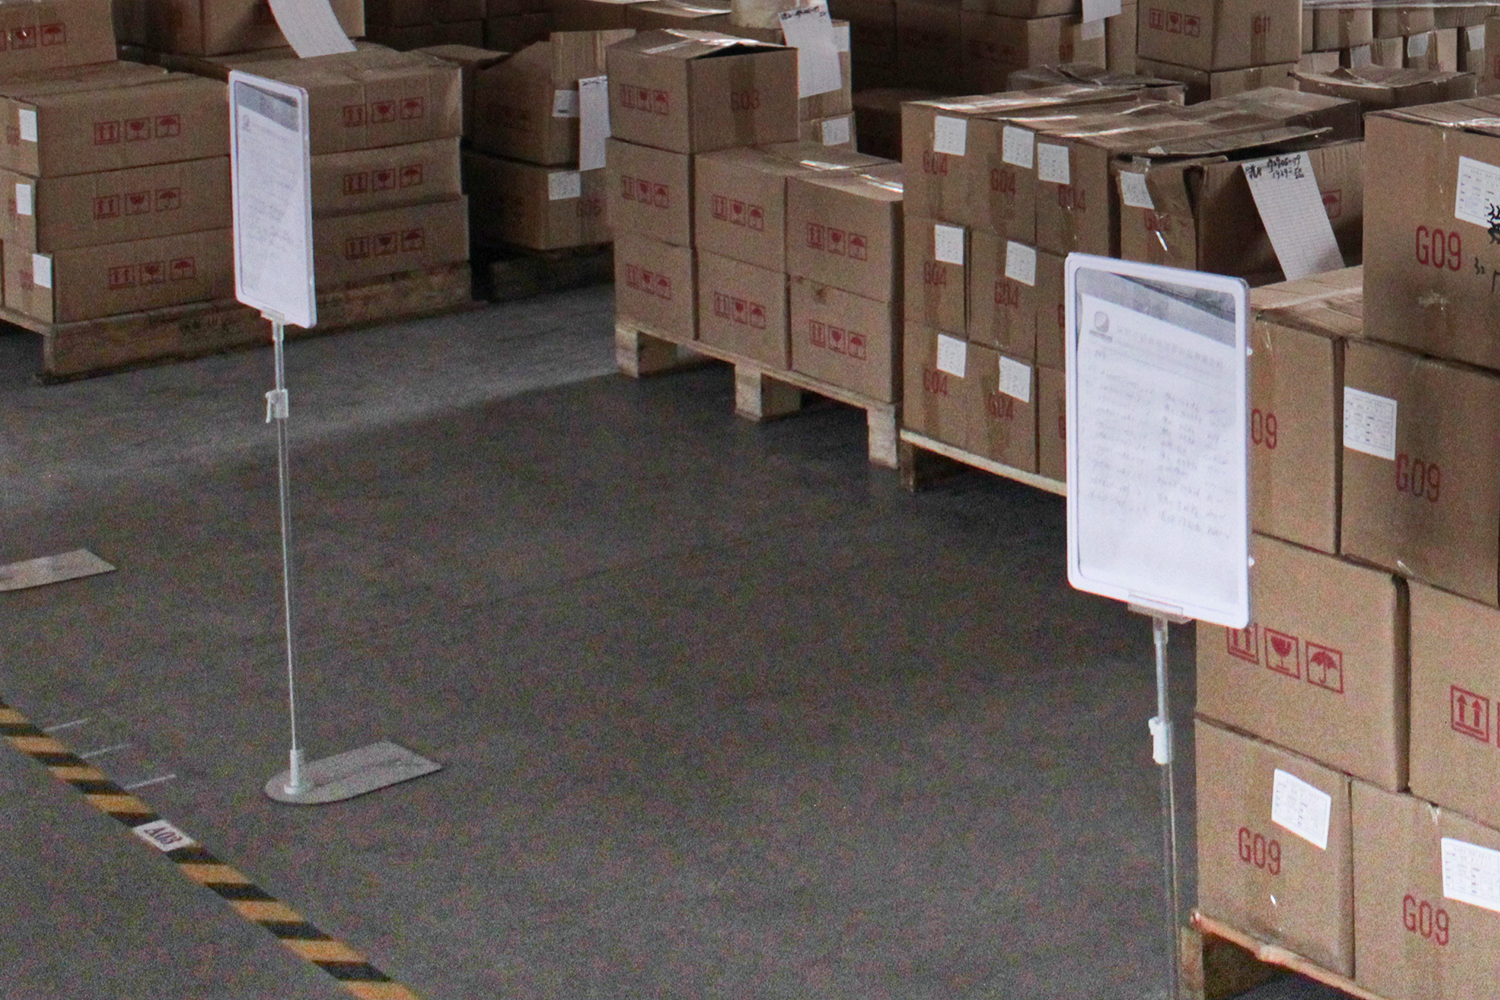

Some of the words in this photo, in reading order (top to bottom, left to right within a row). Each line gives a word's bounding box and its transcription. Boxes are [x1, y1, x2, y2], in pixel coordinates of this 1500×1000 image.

[990, 168, 1017, 196] G04
[1416, 225, 1462, 271] G09
[1251, 408, 1278, 450] 09
[1396, 453, 1441, 502] G09
[1238, 827, 1282, 875] G09
[1402, 894, 1449, 946] G09
